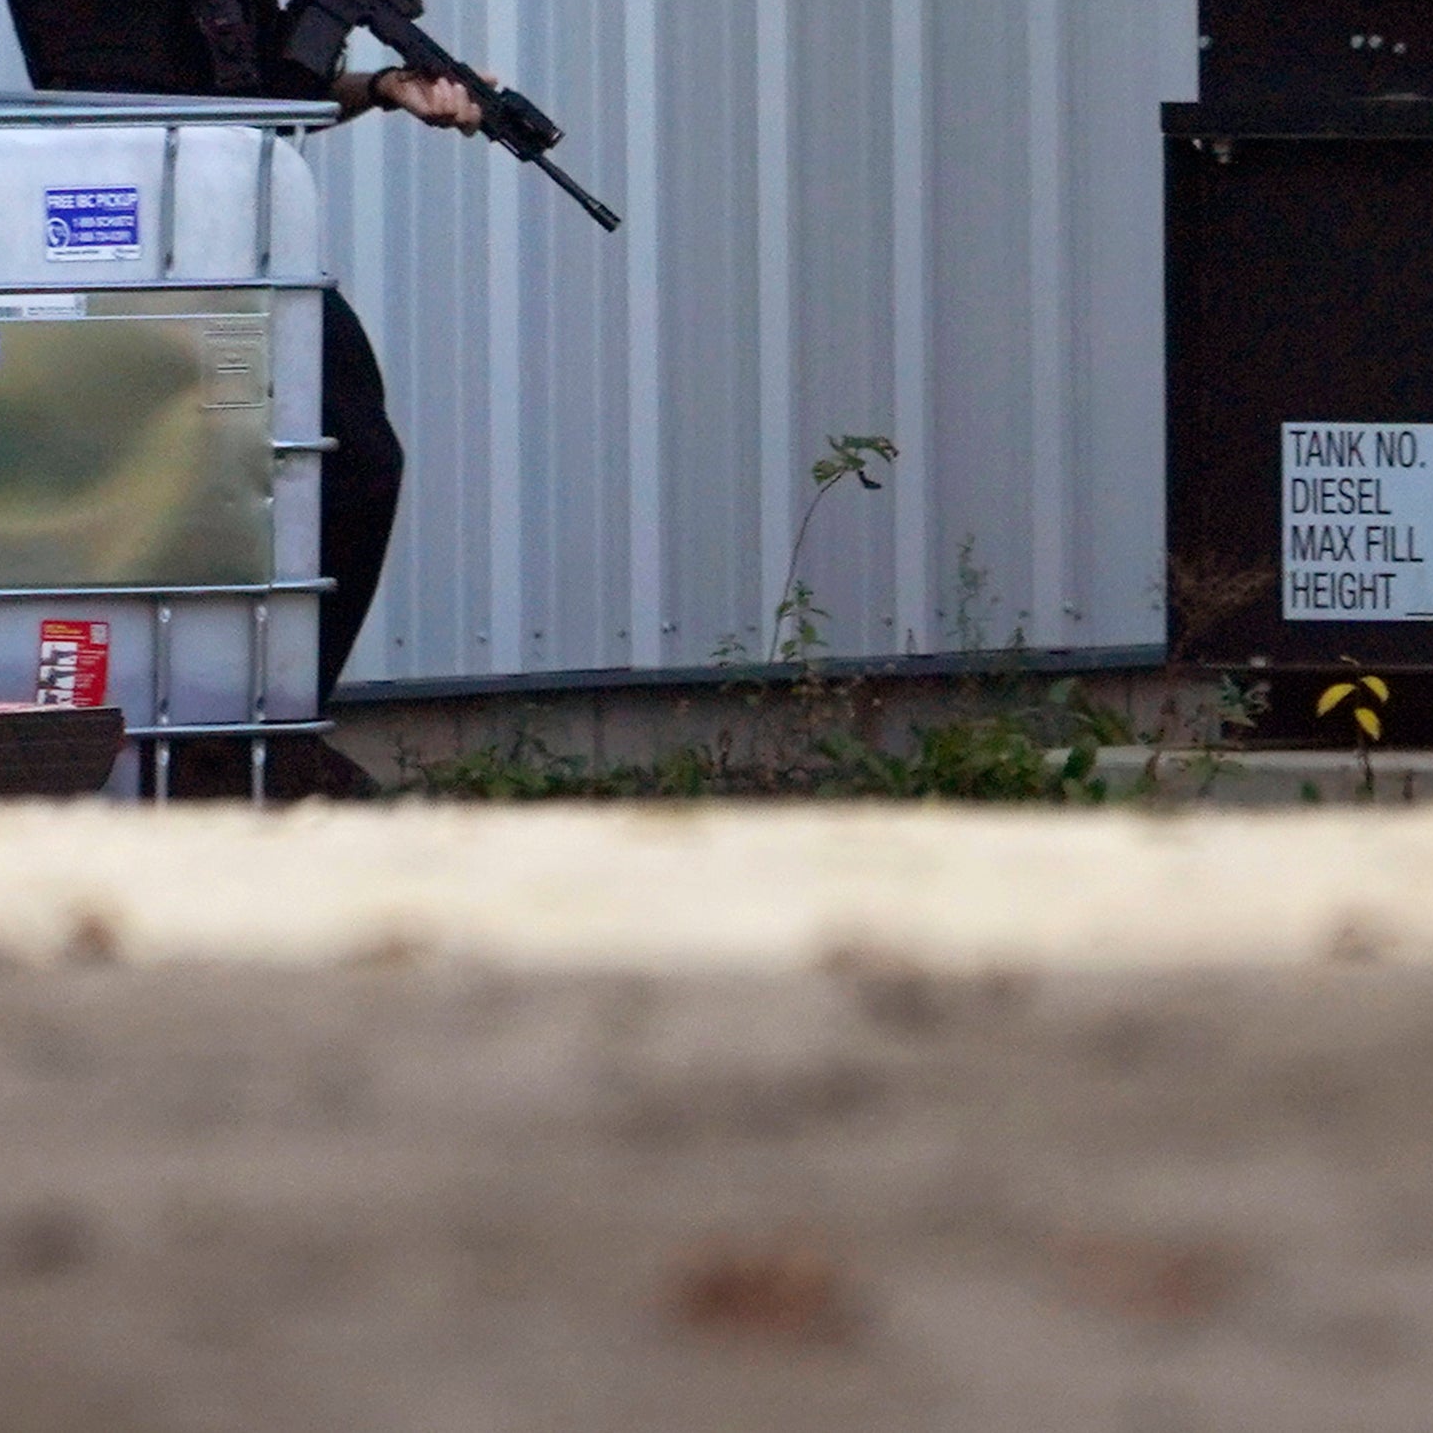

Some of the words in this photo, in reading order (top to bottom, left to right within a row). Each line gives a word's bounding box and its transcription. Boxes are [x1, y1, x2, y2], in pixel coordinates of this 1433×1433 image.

[1289, 430, 1366, 467] TANK
[1376, 430, 1426, 468] NO.
[1291, 478, 1392, 515] DIESEL
[1291, 524, 1356, 562] MAX
[1366, 525, 1424, 563] FILL
[1291, 572, 1397, 610] HEIGHT
